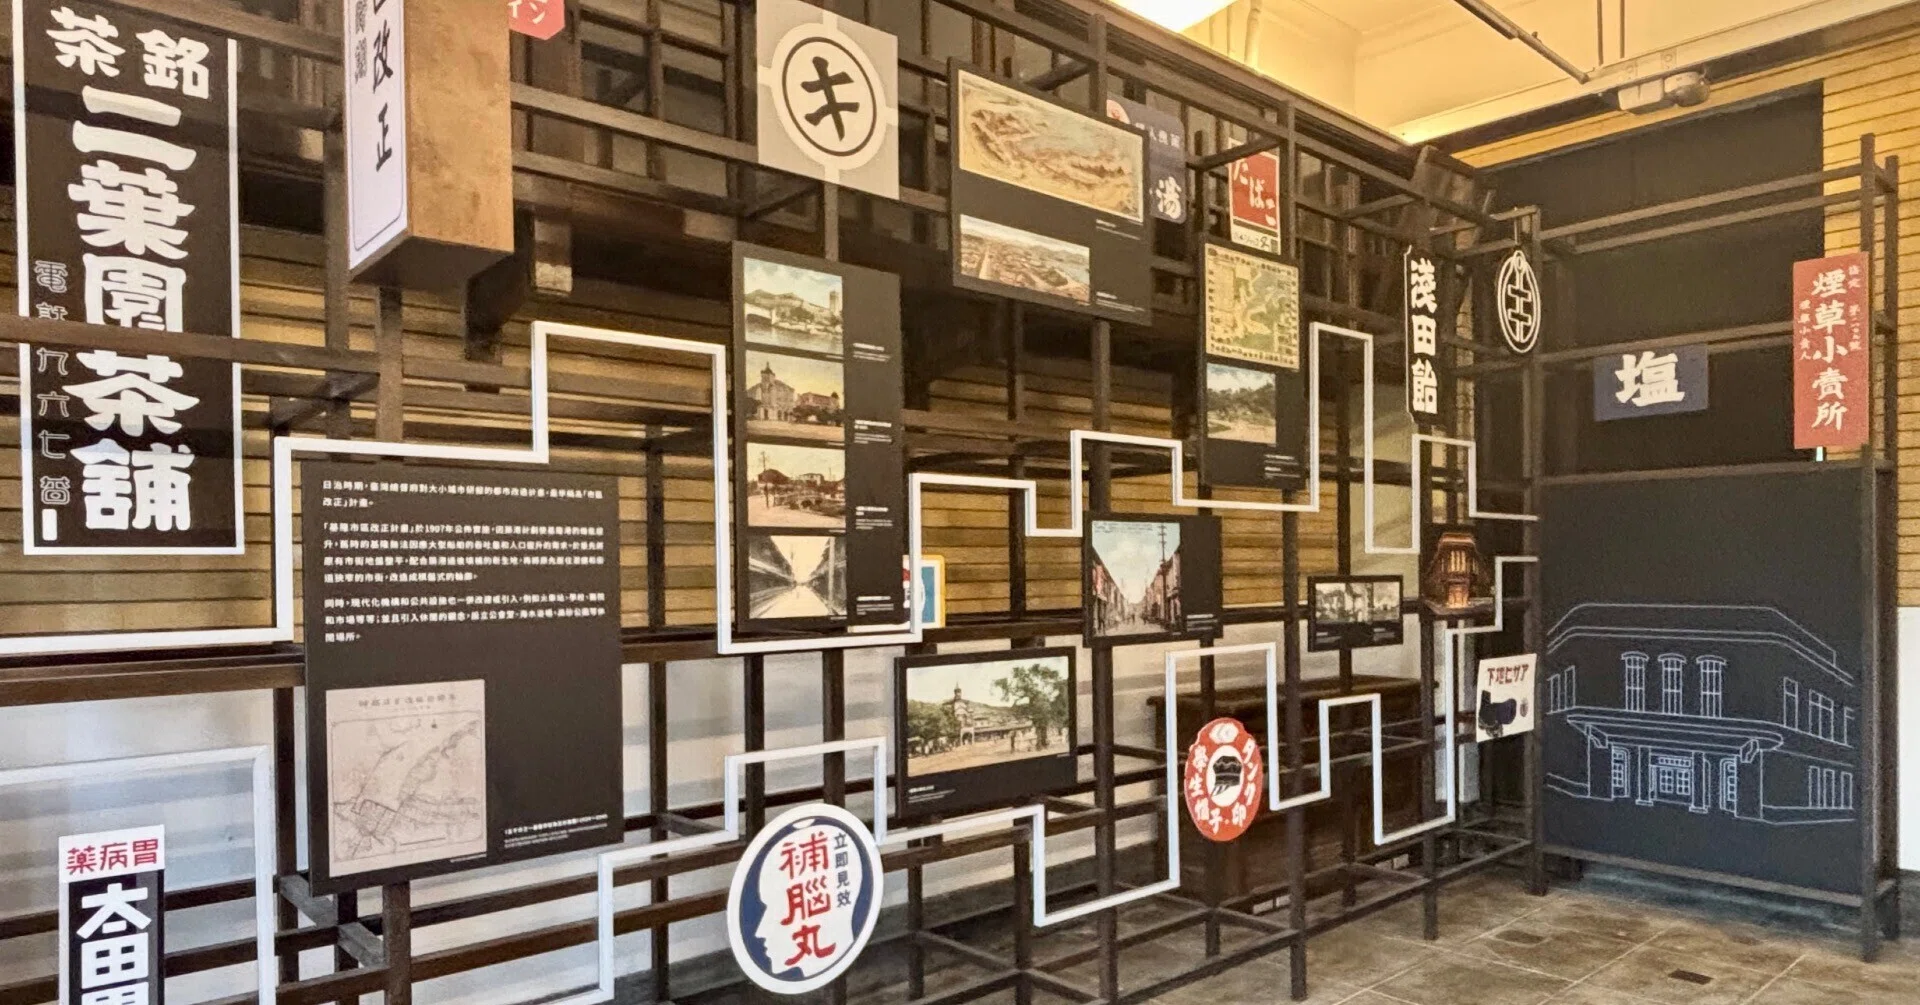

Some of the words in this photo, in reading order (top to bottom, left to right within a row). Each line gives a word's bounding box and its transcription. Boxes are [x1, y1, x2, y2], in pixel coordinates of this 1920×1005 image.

[372, 0, 393, 172] 改正
[1614, 350, 1685, 407] 塩
[779, 831, 836, 967] 補腦丸
